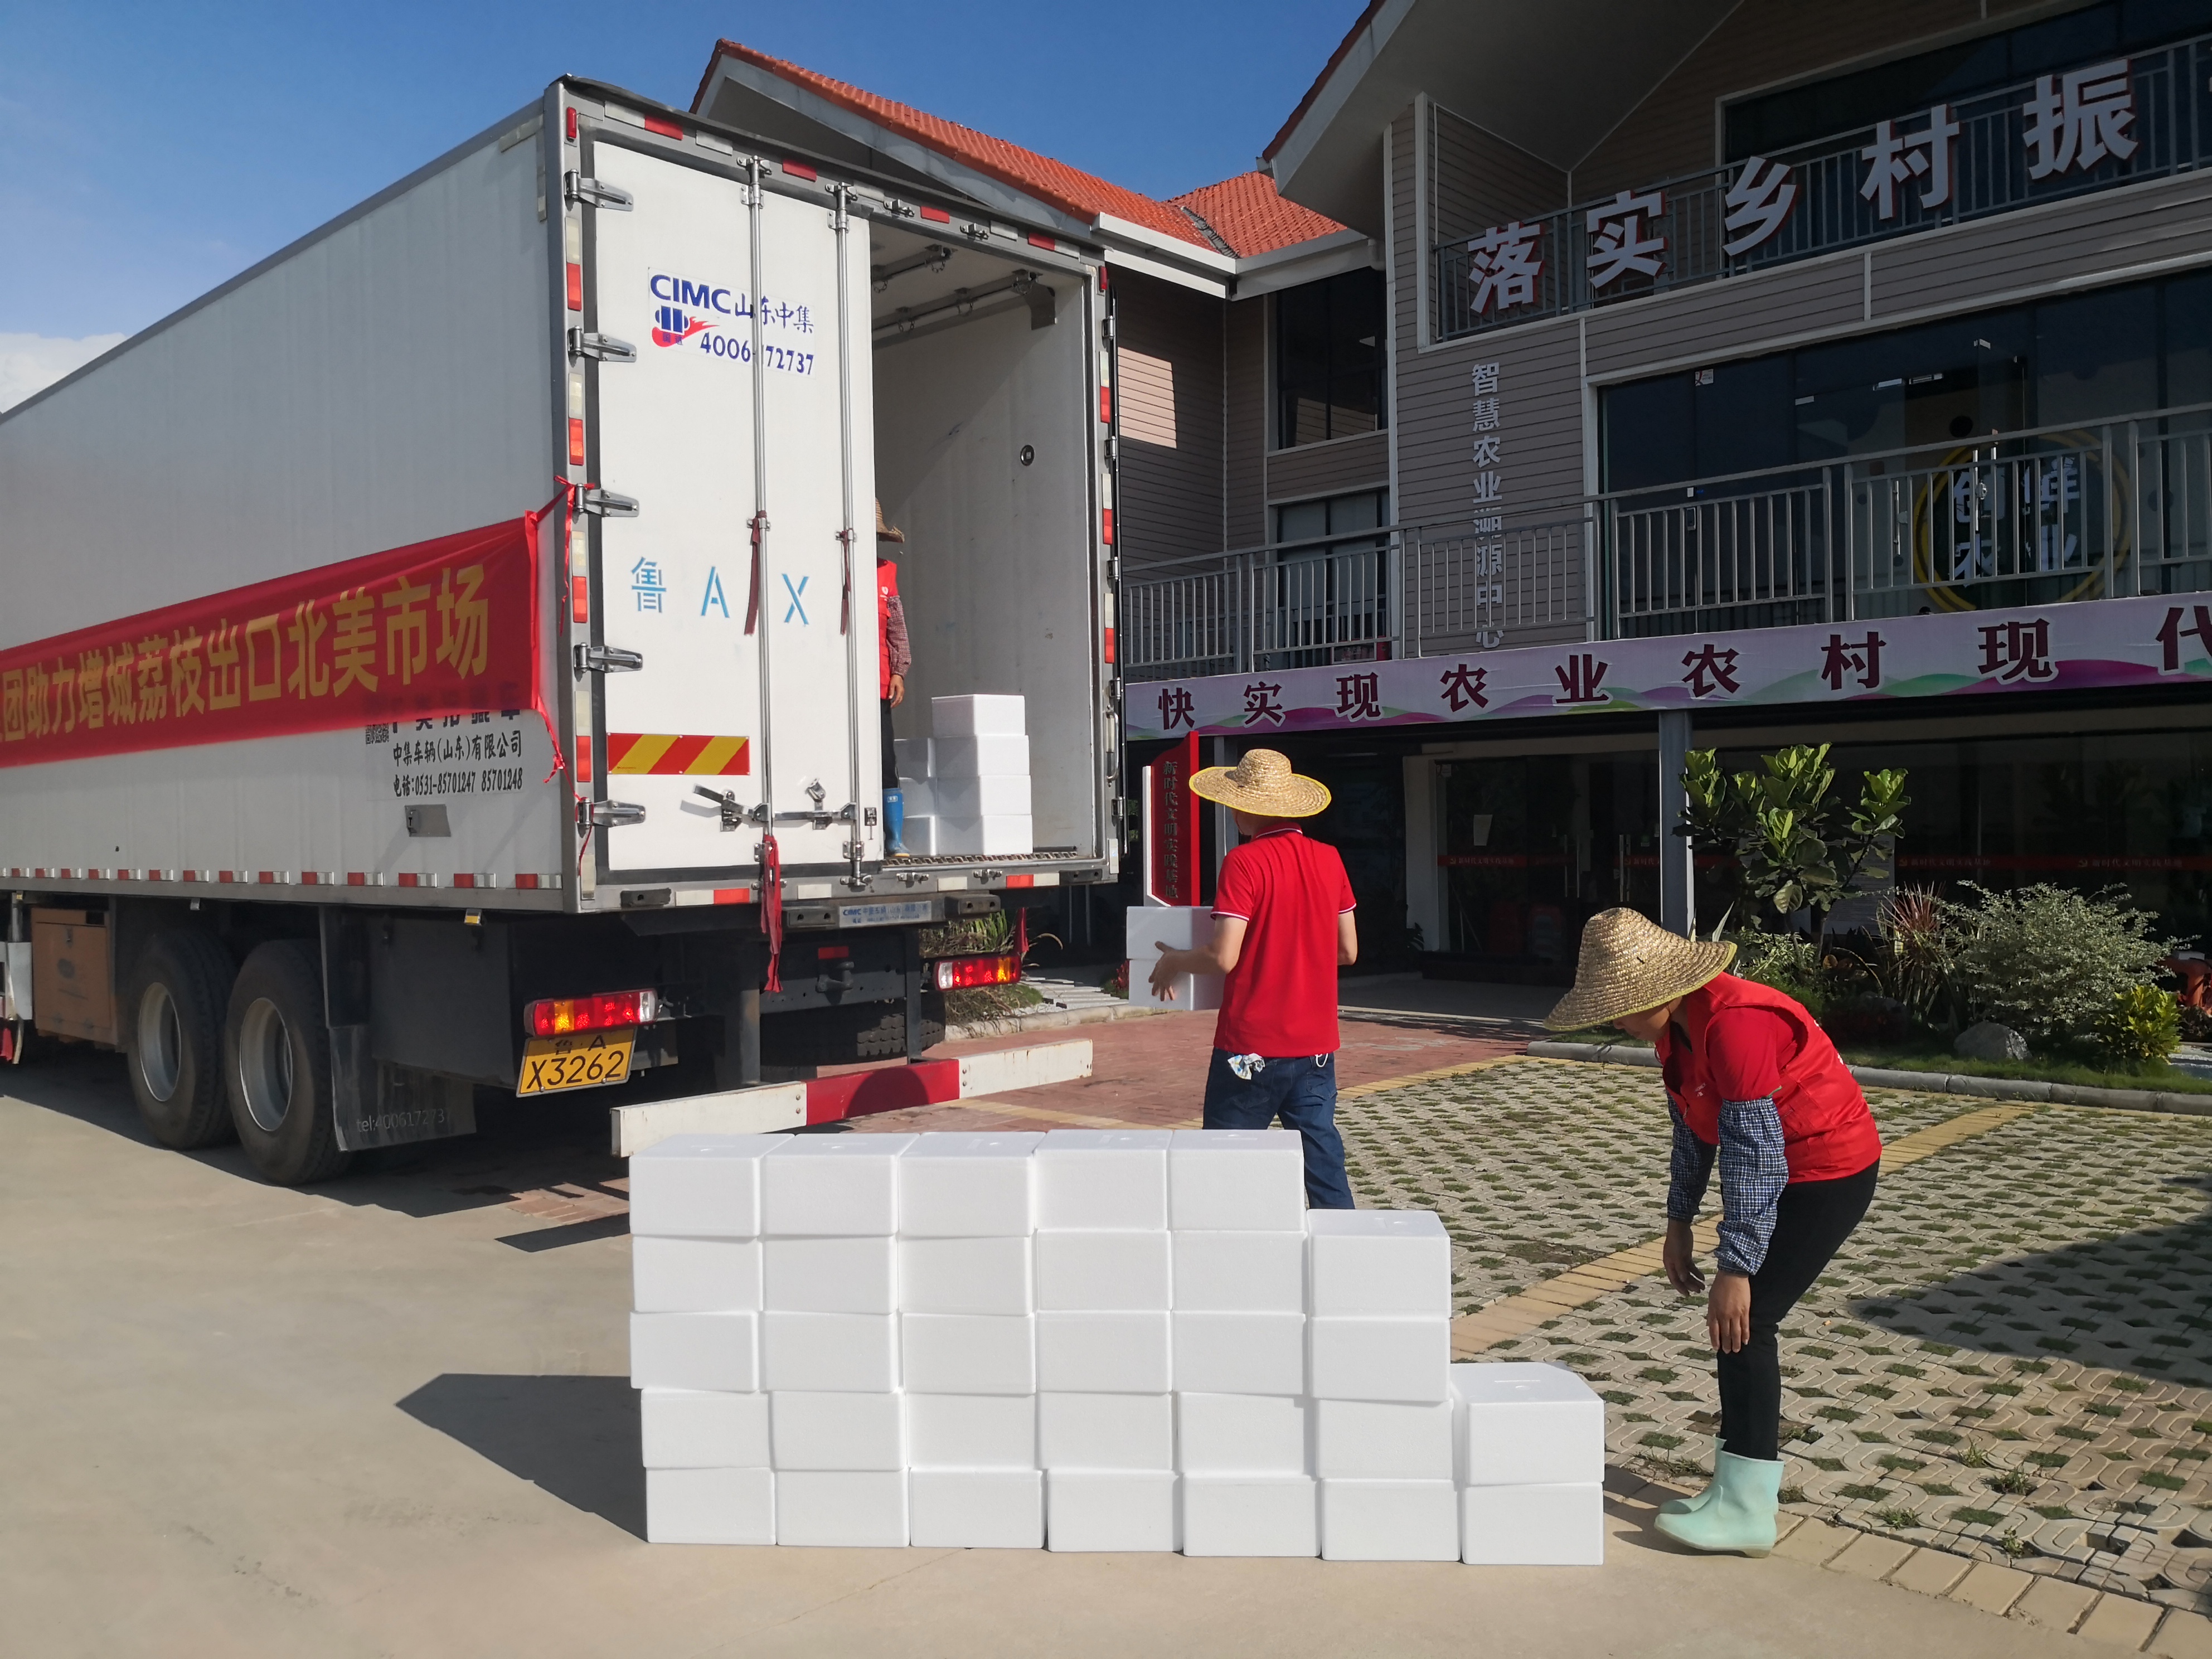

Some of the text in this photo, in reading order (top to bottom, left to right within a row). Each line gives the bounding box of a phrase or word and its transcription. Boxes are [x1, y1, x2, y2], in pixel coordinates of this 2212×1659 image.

[1468, 48, 2212, 313] 落实乡村振
[651, 275, 731, 314] CIMC
[0, 565, 490, 743] 团助力增城荔枝出口北美市场
[393, 730, 522, 767] 中集车辆(山东)有限公司
[393, 767, 523, 797] 电话:0531-85701247 85701248
[526, 1050, 624, 1089] X3262
